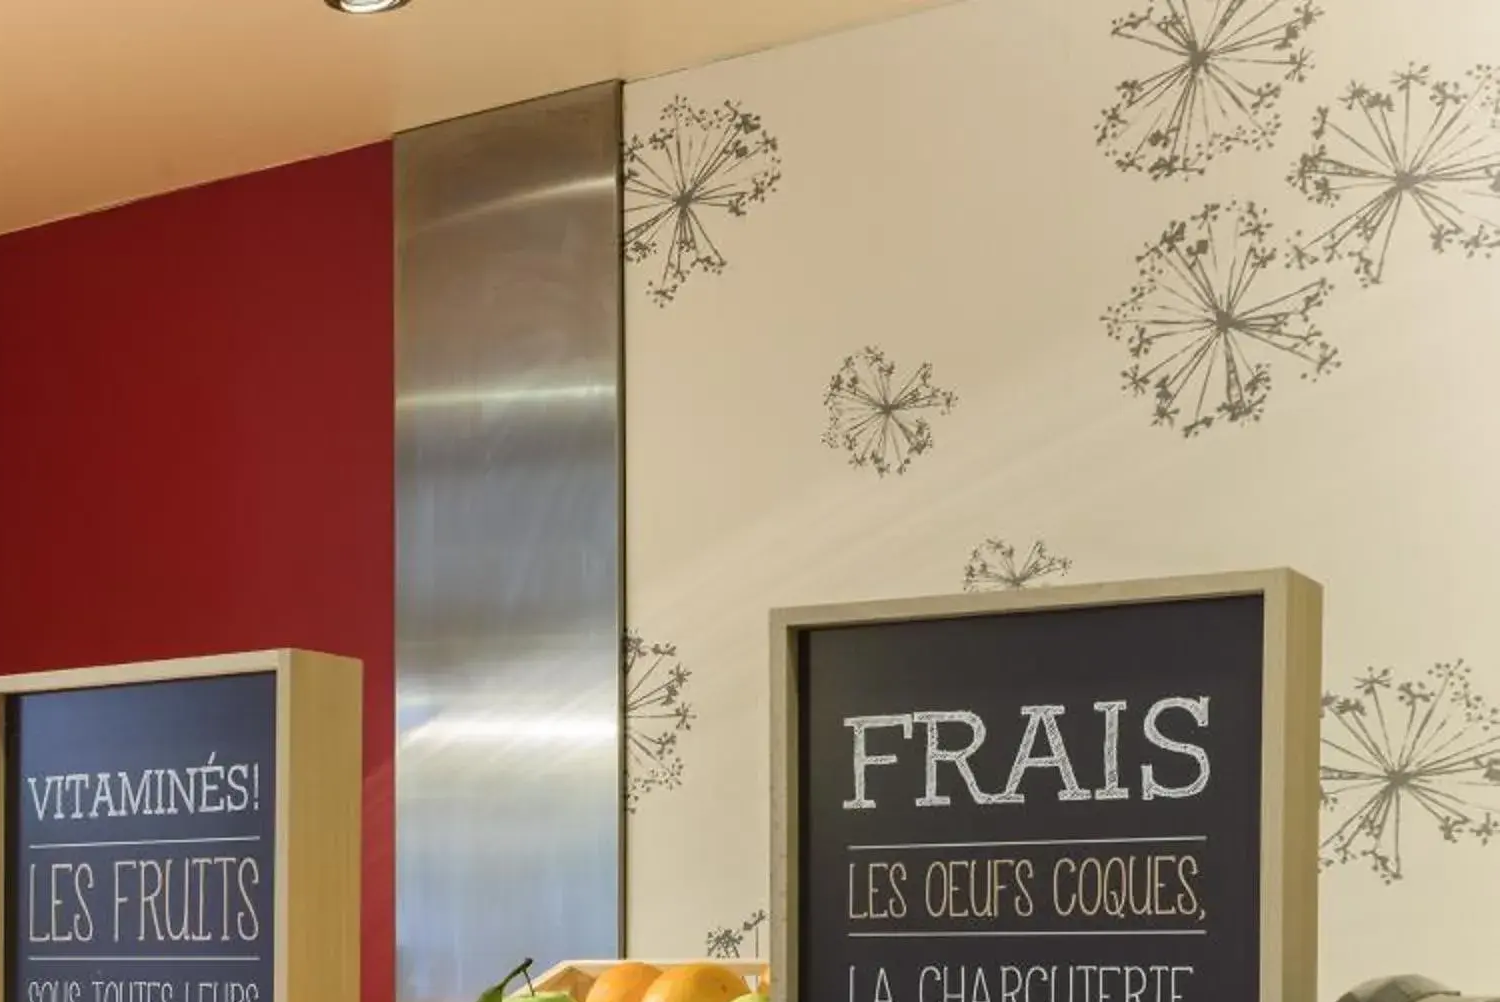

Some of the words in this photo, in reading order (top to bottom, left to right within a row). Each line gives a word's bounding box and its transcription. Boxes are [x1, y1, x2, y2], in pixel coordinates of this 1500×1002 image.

[27, 752, 260, 821] VITAMINÉS!
[842, 696, 1211, 809] FRAIS
[28, 861, 95, 943] LES
[113, 856, 261, 943] FRUITS
[848, 862, 908, 920] LES
[1052, 853, 1207, 922] COQUES,
